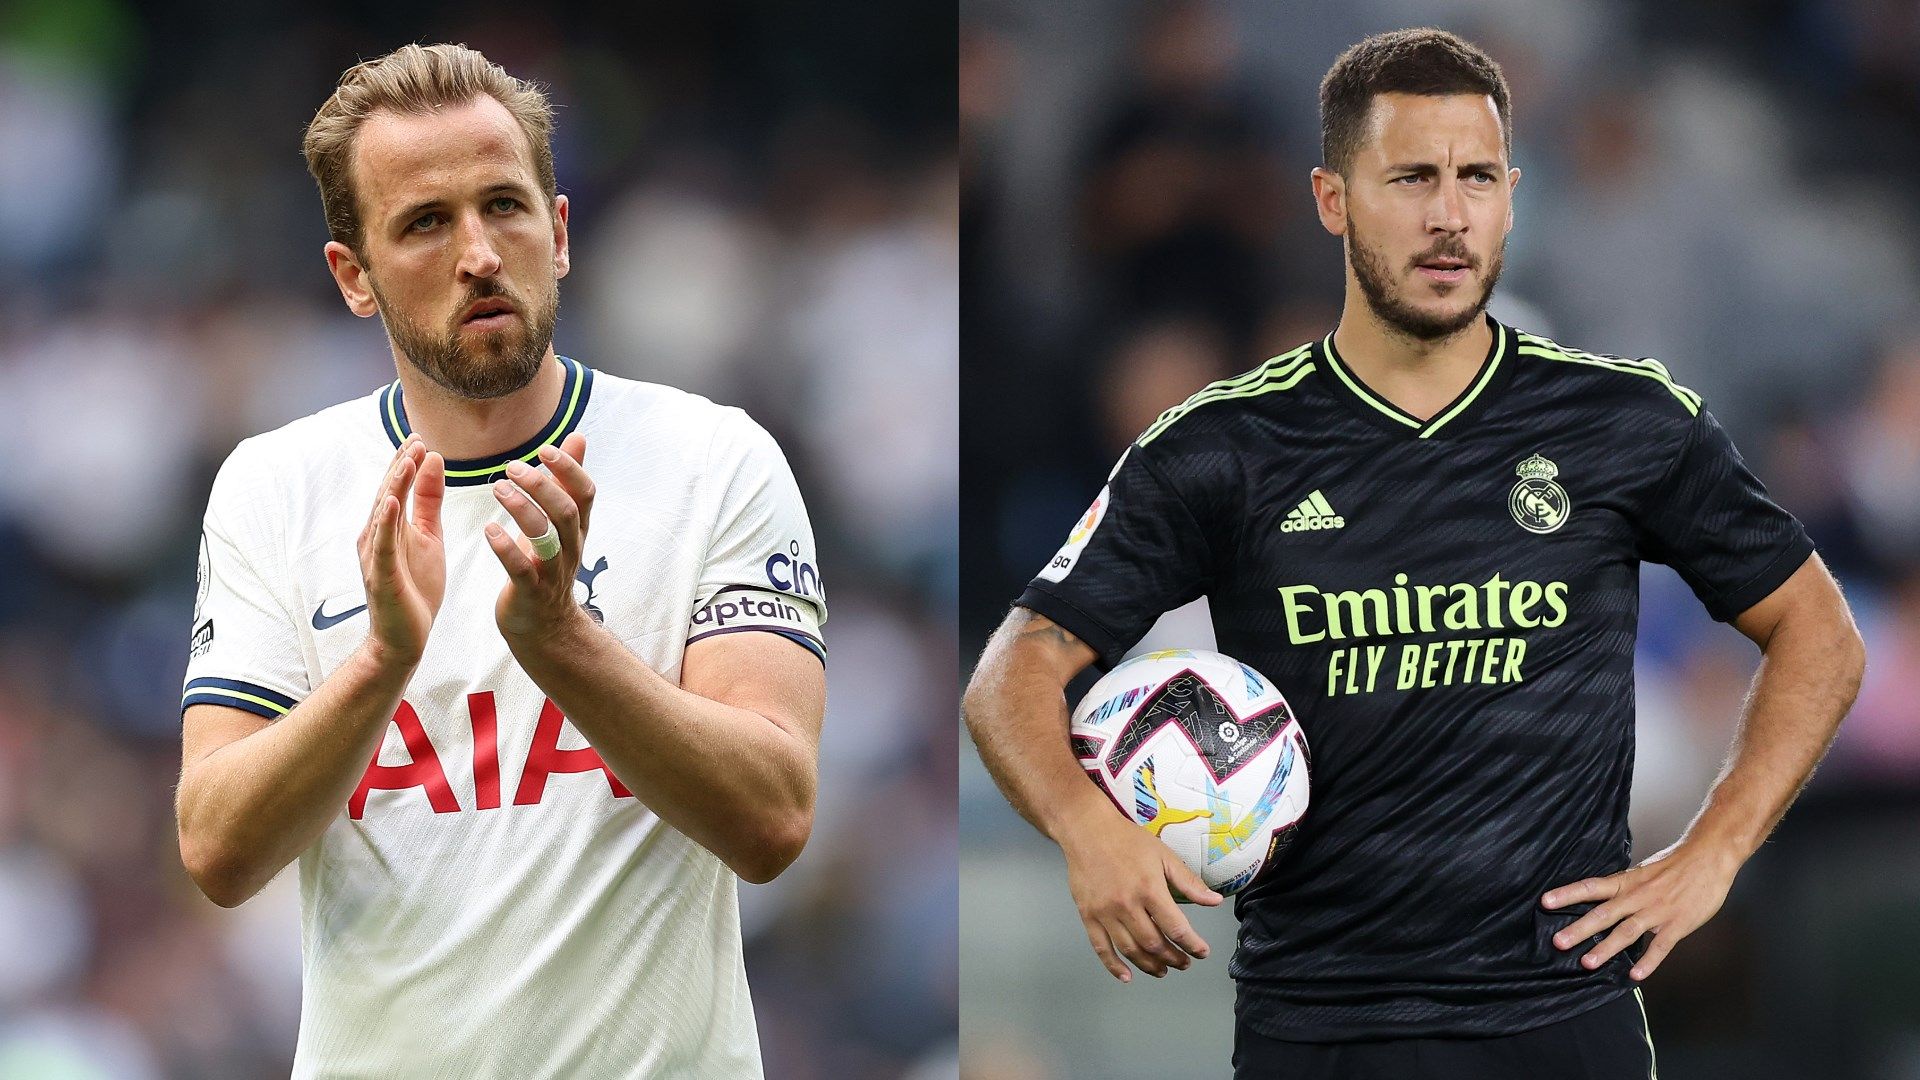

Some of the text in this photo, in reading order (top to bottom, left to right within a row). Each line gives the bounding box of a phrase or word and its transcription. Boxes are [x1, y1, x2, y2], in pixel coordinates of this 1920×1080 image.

[1280, 515, 1345, 533] adidas
[1278, 572, 1568, 645] Emirates
[1327, 638, 1527, 697] FLY BETTER
[348, 690, 634, 820] AIA
